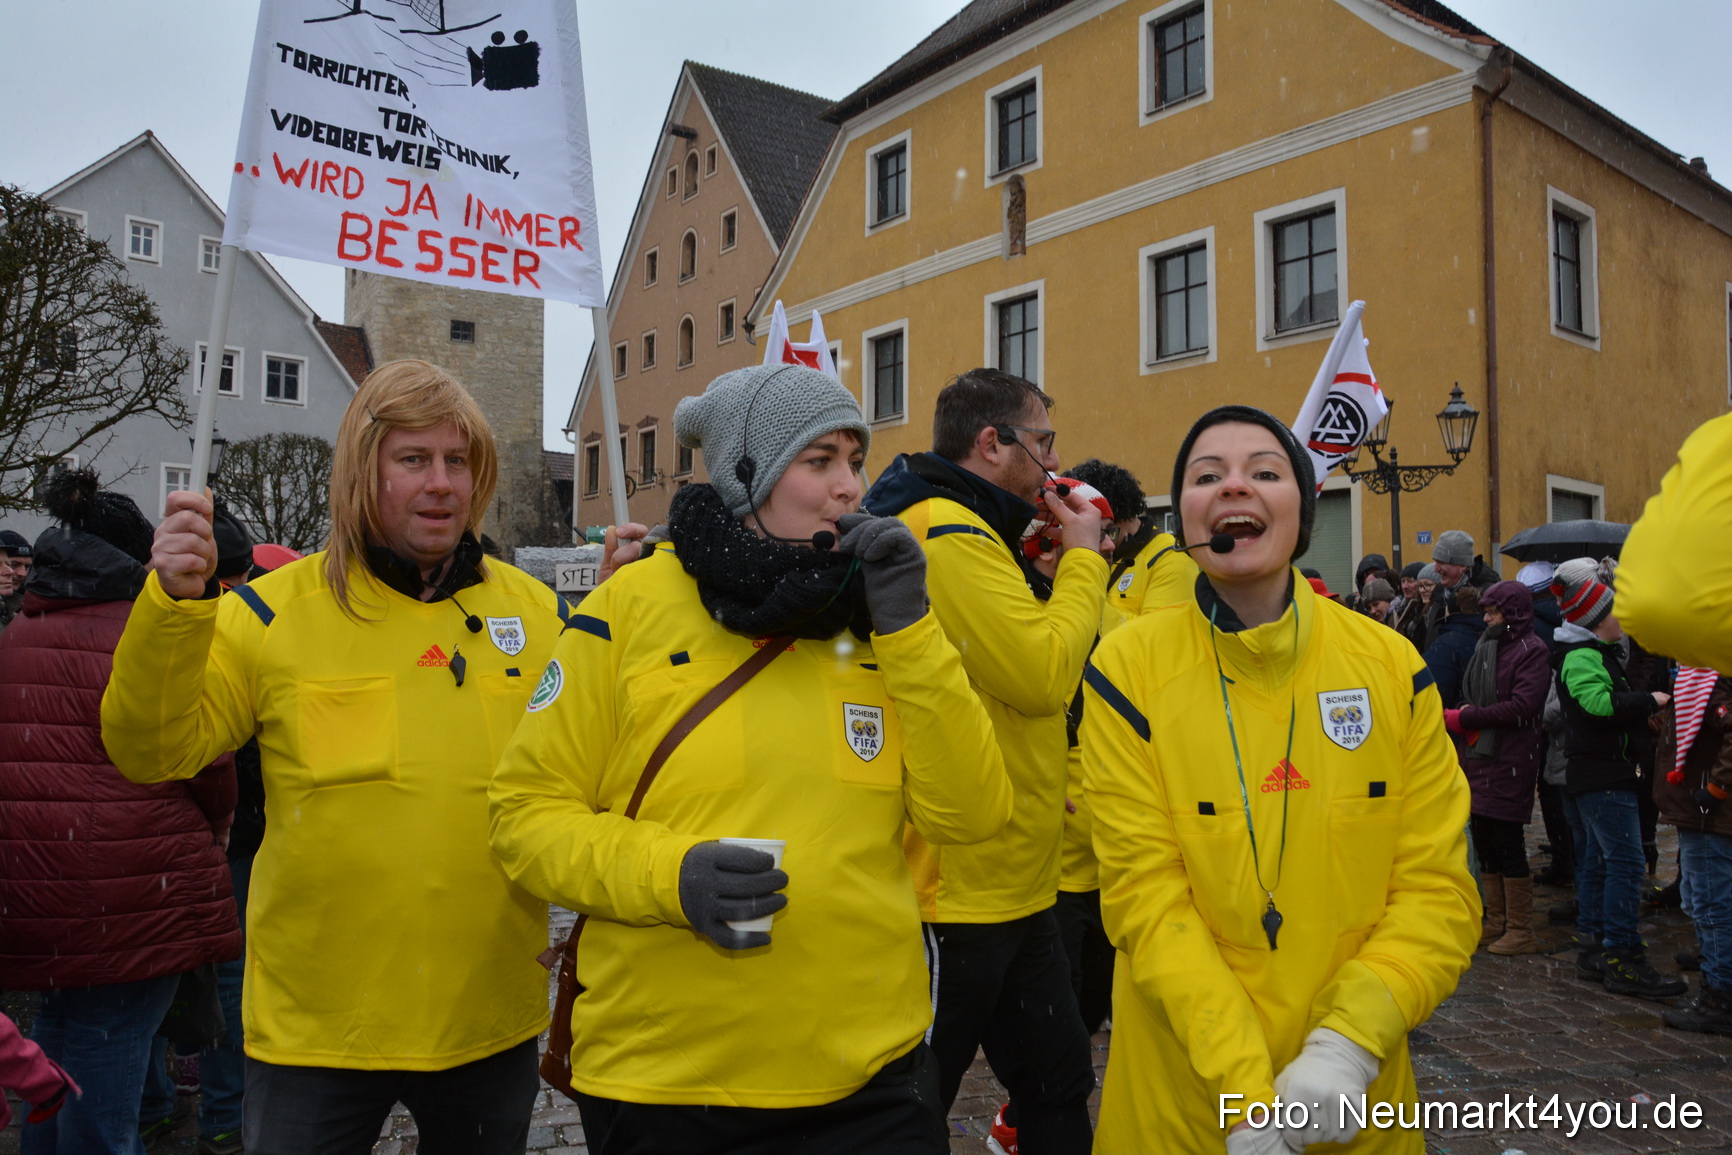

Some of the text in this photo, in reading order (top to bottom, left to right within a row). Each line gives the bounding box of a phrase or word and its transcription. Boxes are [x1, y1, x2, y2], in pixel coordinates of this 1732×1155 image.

[276, 42, 416, 109] TORRICHTER,
[270, 108, 442, 172] VIDEOBEWEIS
[384, 177, 439, 221] JA
[464, 193, 584, 252] IMMER
[337, 211, 541, 290] BESSER
[499, 639, 521, 647] FIFA
[416, 658, 452, 668] adida
[1325, 694, 1364, 705] SCHEISS
[849, 708, 879, 719] SCHEISS
[1334, 725, 1364, 736] FIFA
[854, 737, 877, 749] FIFA
[1342, 735, 1361, 744] 2018
[859, 748, 875, 757] 2018
[1261, 779, 1310, 793] adidas
